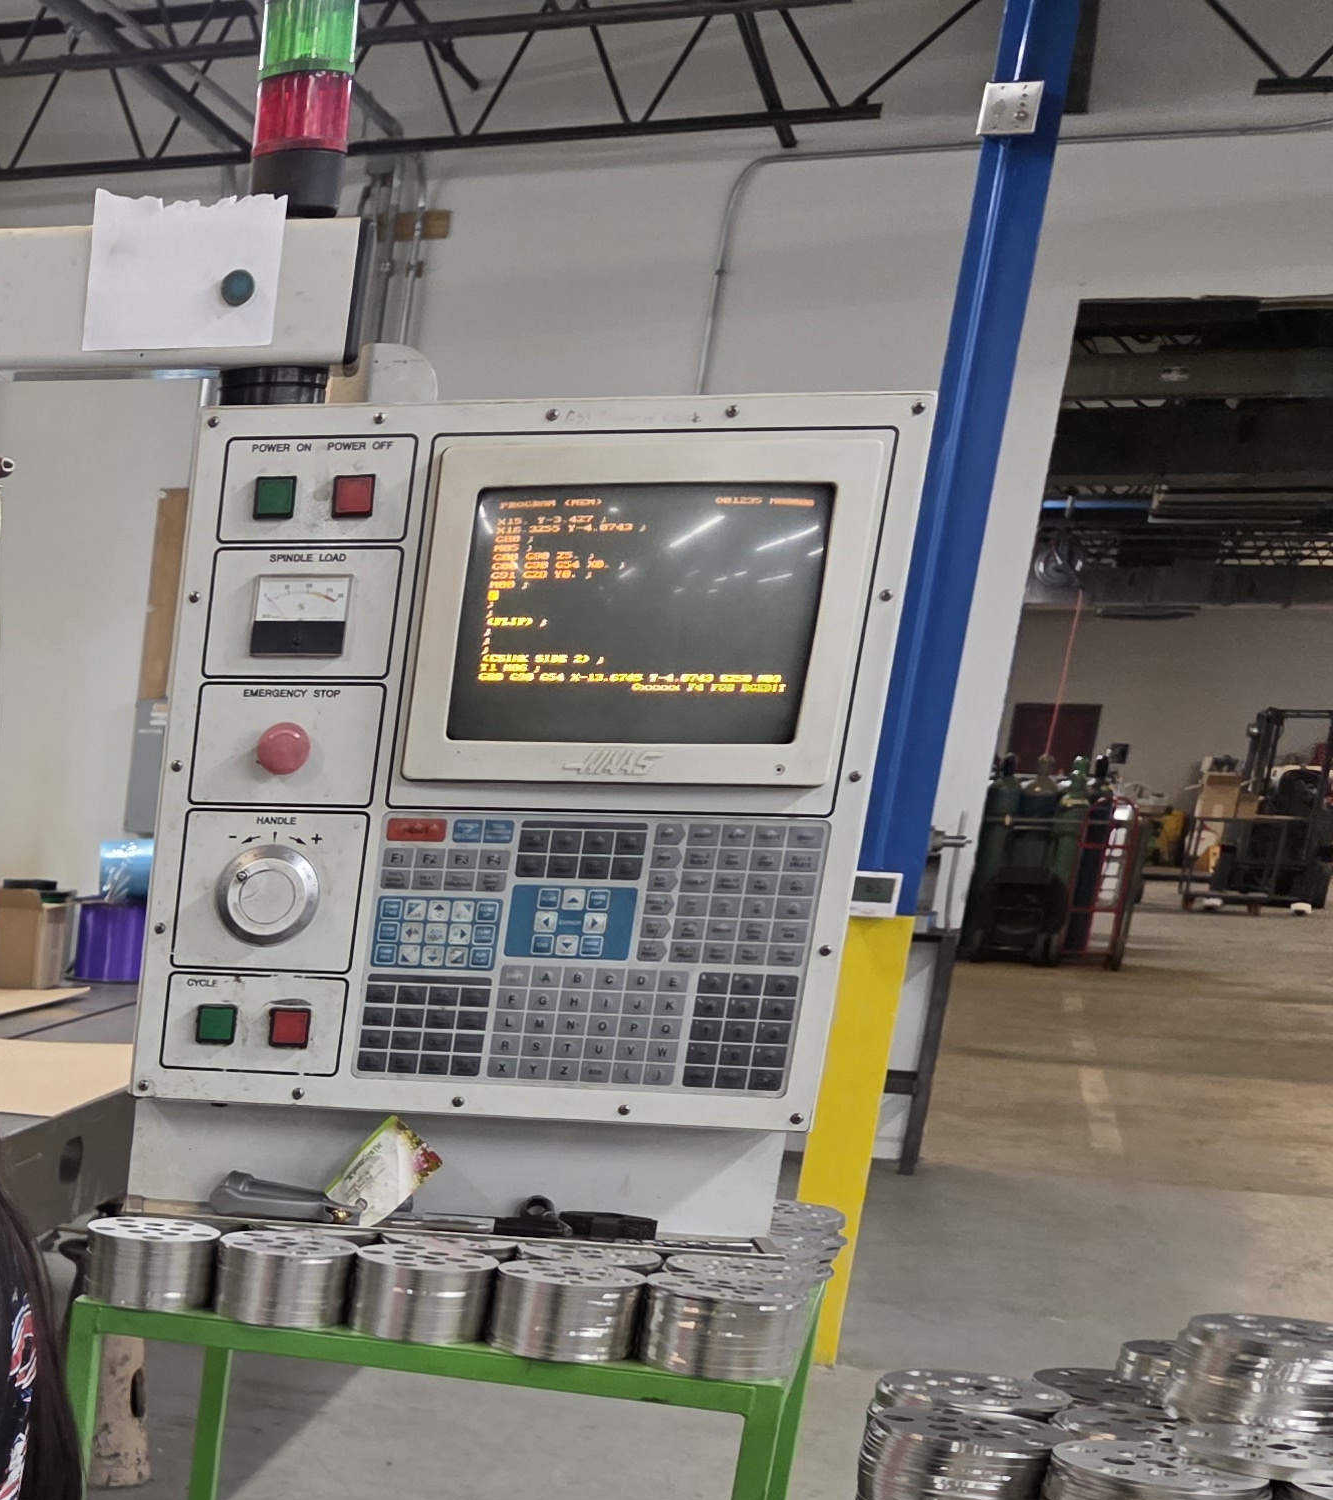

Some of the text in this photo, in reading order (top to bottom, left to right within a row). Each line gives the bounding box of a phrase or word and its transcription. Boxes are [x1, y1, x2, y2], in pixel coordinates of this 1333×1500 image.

[252, 443, 312, 453] POWER ON
[327, 441, 394, 451] POWER OFF
[269, 553, 346, 563] SPINDLE LOAD
[243, 689, 341, 698] EMERGENCY STOP
[256, 816, 297, 825] HANDLE
[391, 853, 404, 863] F1
[422, 854, 437, 864] F2
[454, 854, 469, 865] F3
[486, 855, 501, 865] F4
[541, 973, 551, 982] A
[573, 974, 582, 983] B
[605, 975, 614, 984] C
[637, 976, 646, 985] D
[669, 977, 677, 987] E
[186, 978, 218, 988] CYCLE
[508, 995, 515, 1004] F
[538, 997, 547, 1006] G
[570, 998, 579, 1007] H
[634, 1001, 641, 1009] J
[665, 1002, 674, 1010] K
[505, 1019, 512, 1027] L
[535, 1020, 544, 1029] M
[566, 1021, 575, 1030] N
[597, 1022, 607, 1031] O
[630, 1023, 638, 1032] P
[662, 1024, 671, 1034] Q
[501, 1041, 509, 1049] R
[532, 1042, 540, 1051] S
[564, 1043, 572, 1052] T
[595, 1045, 603, 1054] U
[627, 1046, 635, 1055] V
[657, 1047, 668, 1057] W
[498, 1063, 506, 1072] X
[529, 1064, 537, 1073] Y
[559, 1066, 569, 1075] Z
